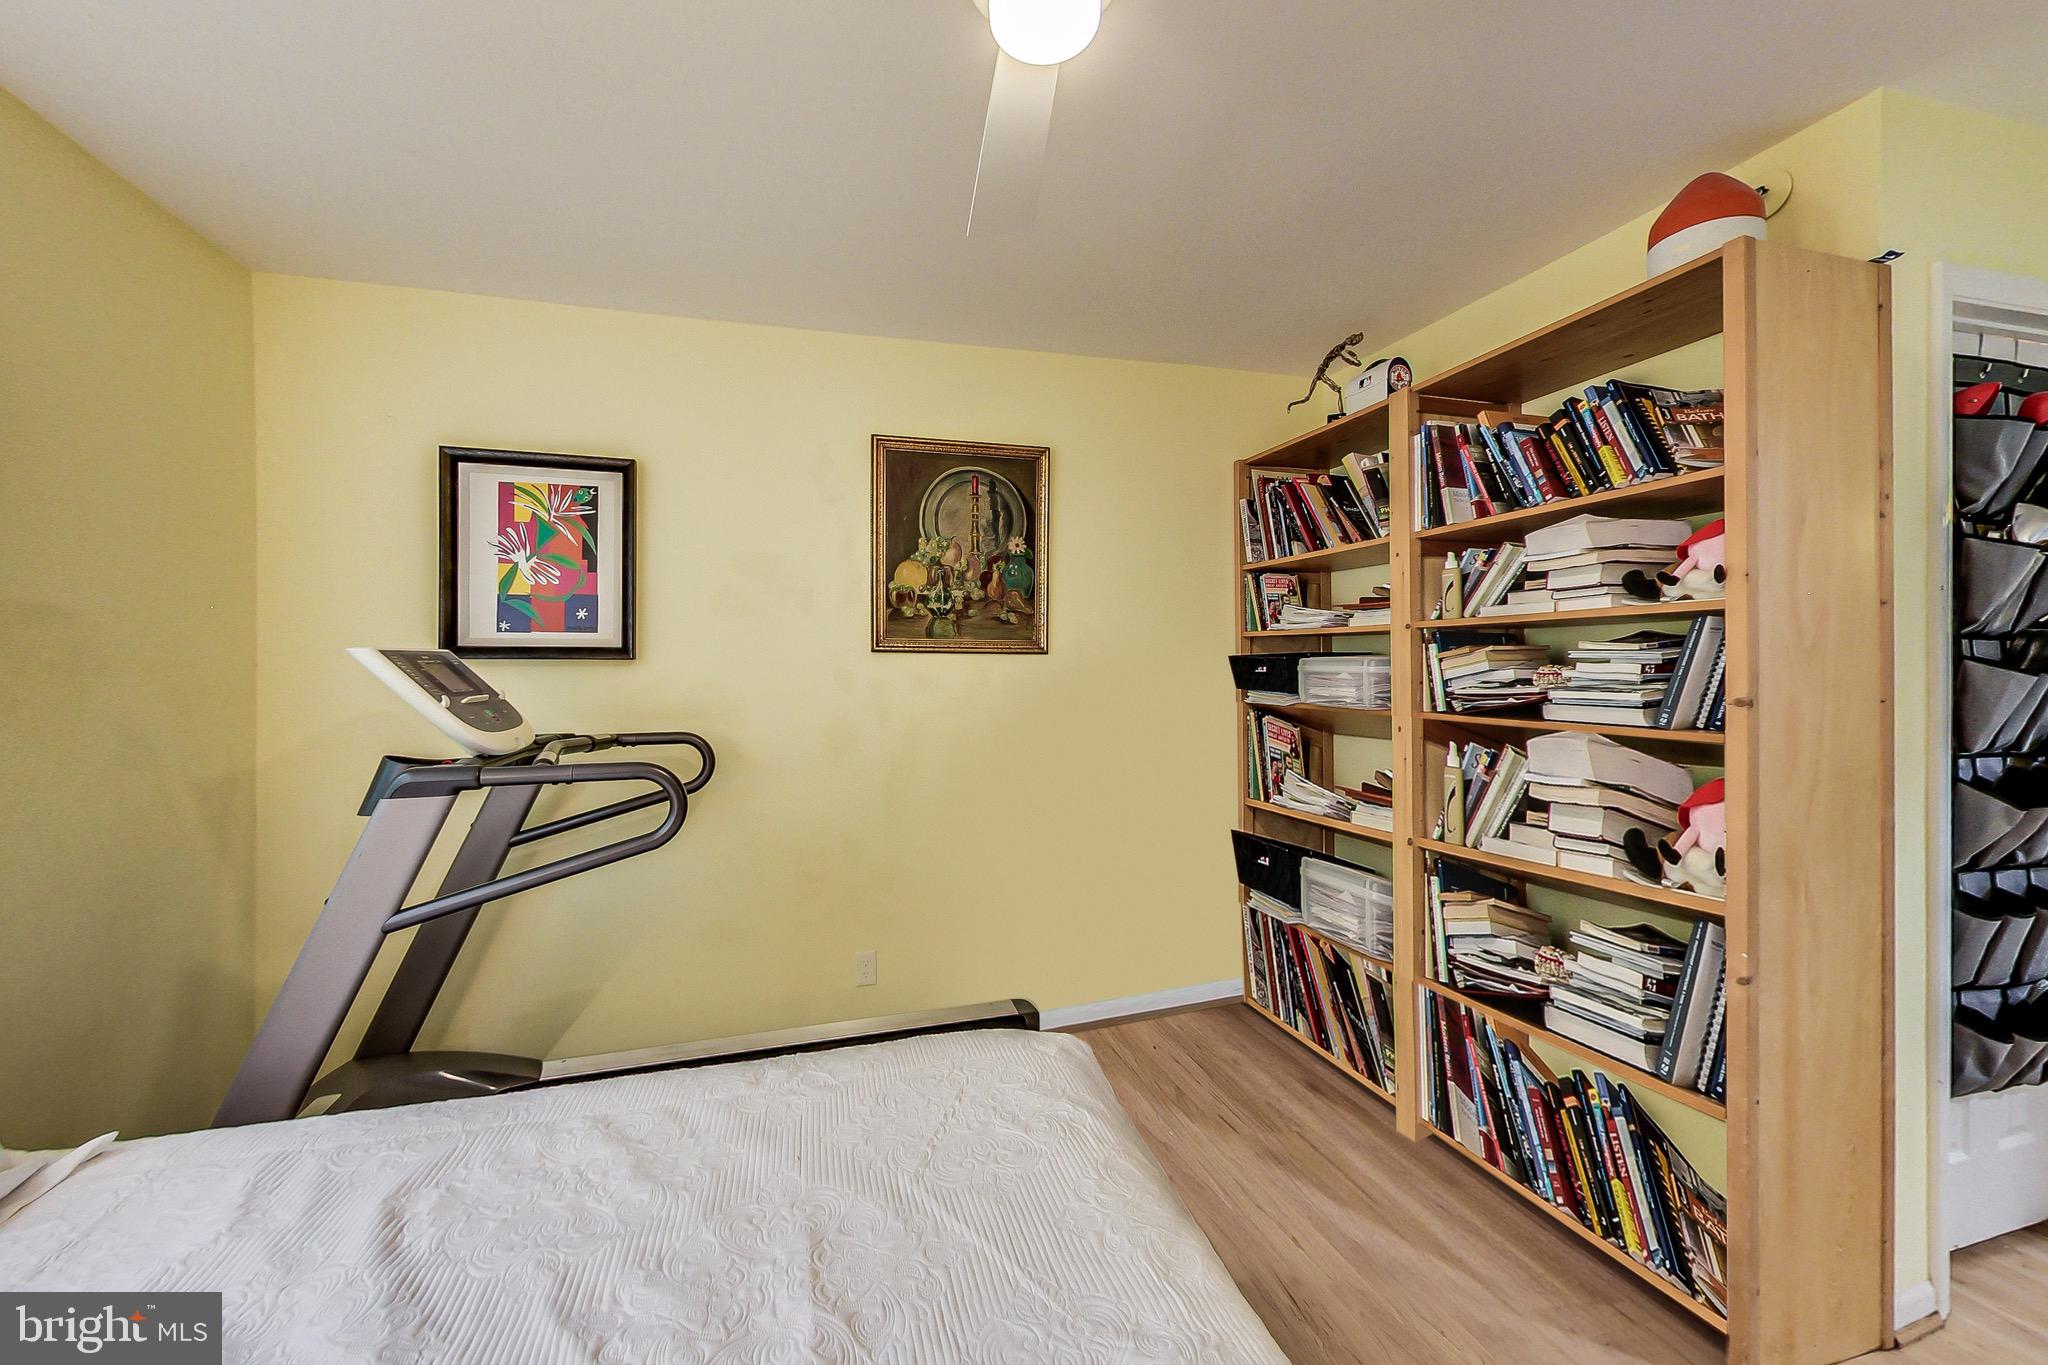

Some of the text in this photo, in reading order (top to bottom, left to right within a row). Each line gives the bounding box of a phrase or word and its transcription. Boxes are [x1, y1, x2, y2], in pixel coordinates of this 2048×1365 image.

[1598, 416, 1614, 442] LISTEN
[1676, 411, 1724, 421] BATH
[1609, 1132, 1627, 1178] LISTEN
[1692, 1204, 1727, 1245] BAT
